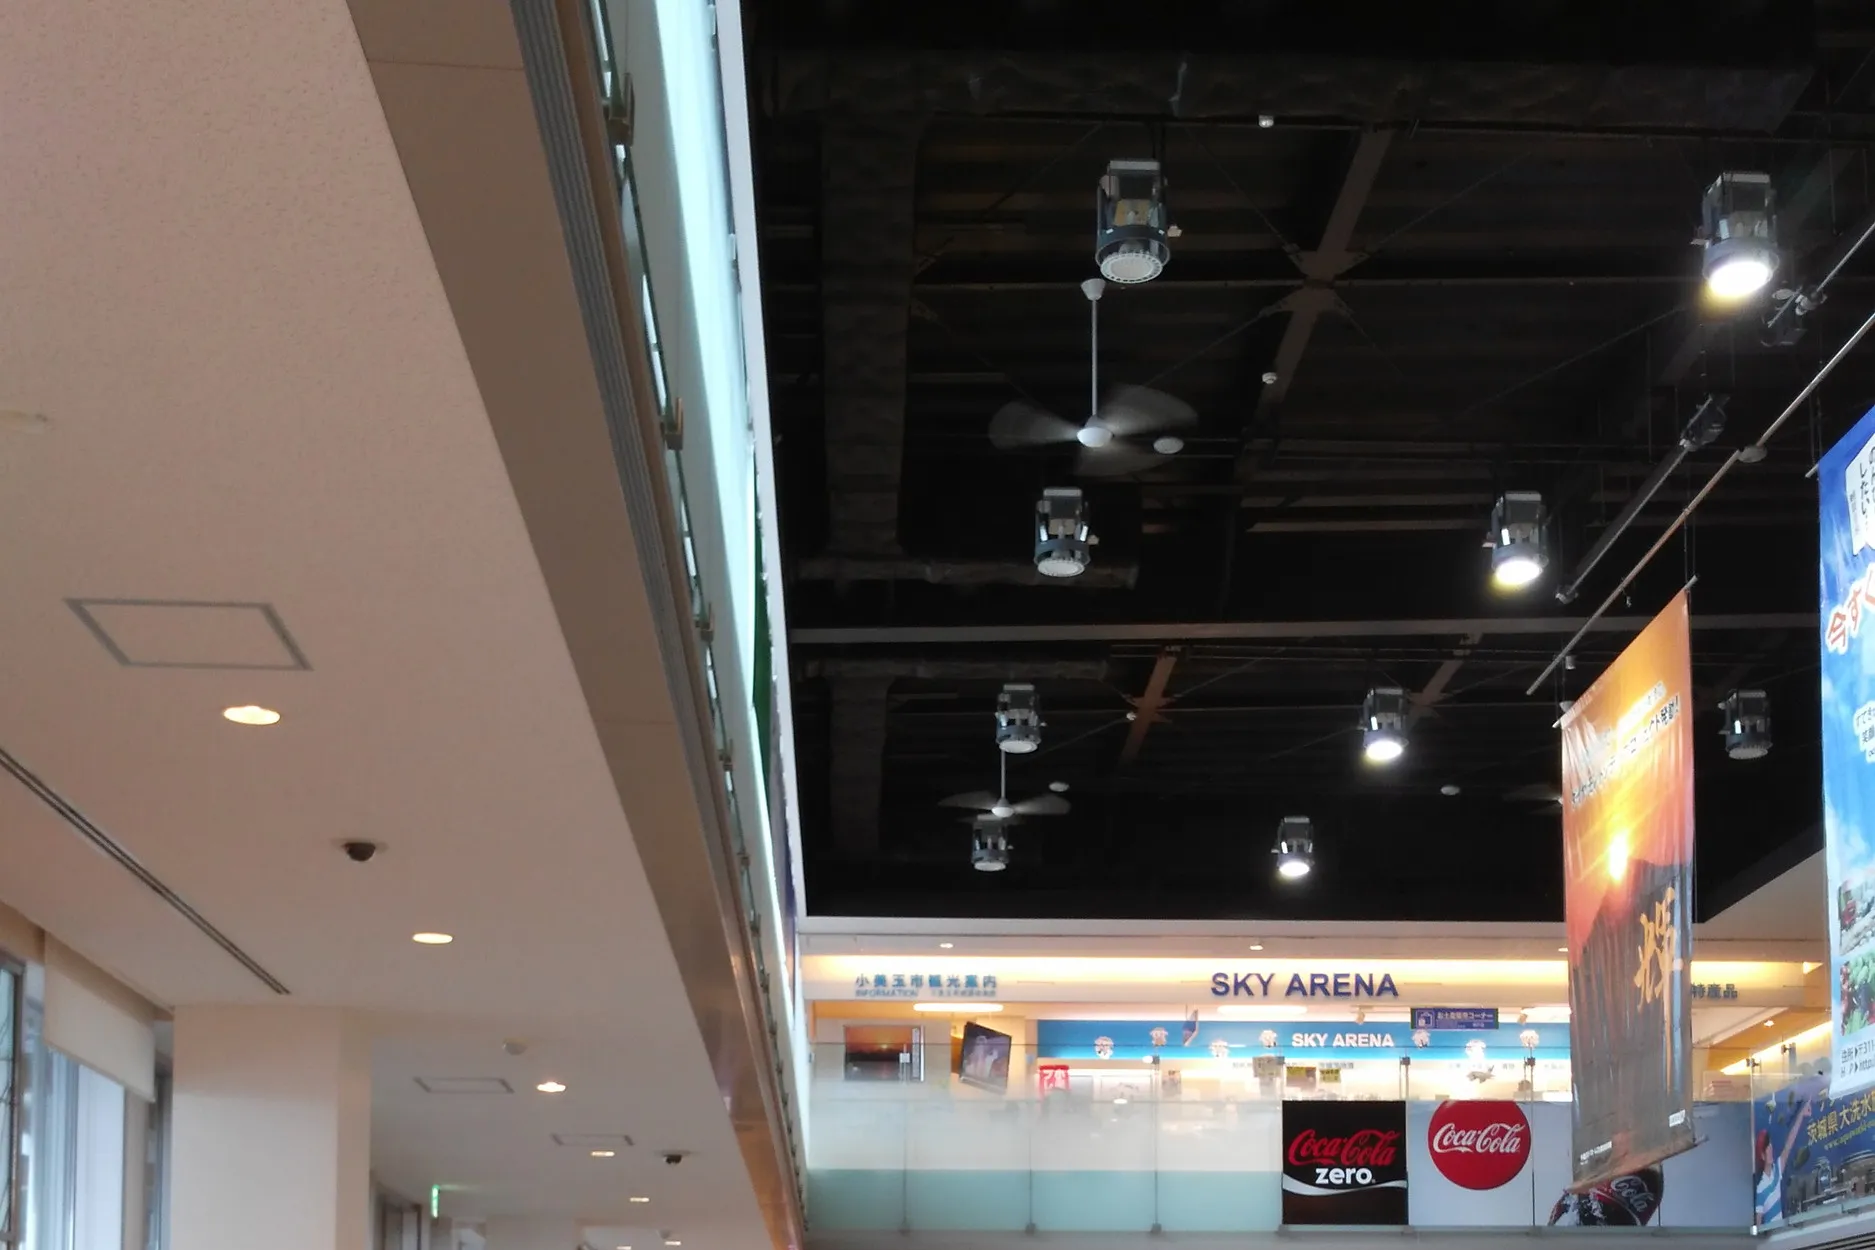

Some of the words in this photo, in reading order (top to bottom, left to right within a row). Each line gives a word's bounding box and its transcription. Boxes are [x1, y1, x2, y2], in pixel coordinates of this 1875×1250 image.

[855, 974, 997, 988] 小美玉市観光案内
[1211, 972, 1275, 997] SKY
[1285, 973, 1399, 997] ARENA
[1292, 1033, 1327, 1047] SKY
[1332, 1033, 1395, 1047] ARENA
[1288, 1129, 1401, 1166] Coca-Cola
[1433, 1123, 1526, 1153] Coca-Cola
[1315, 1167, 1373, 1184] zero
